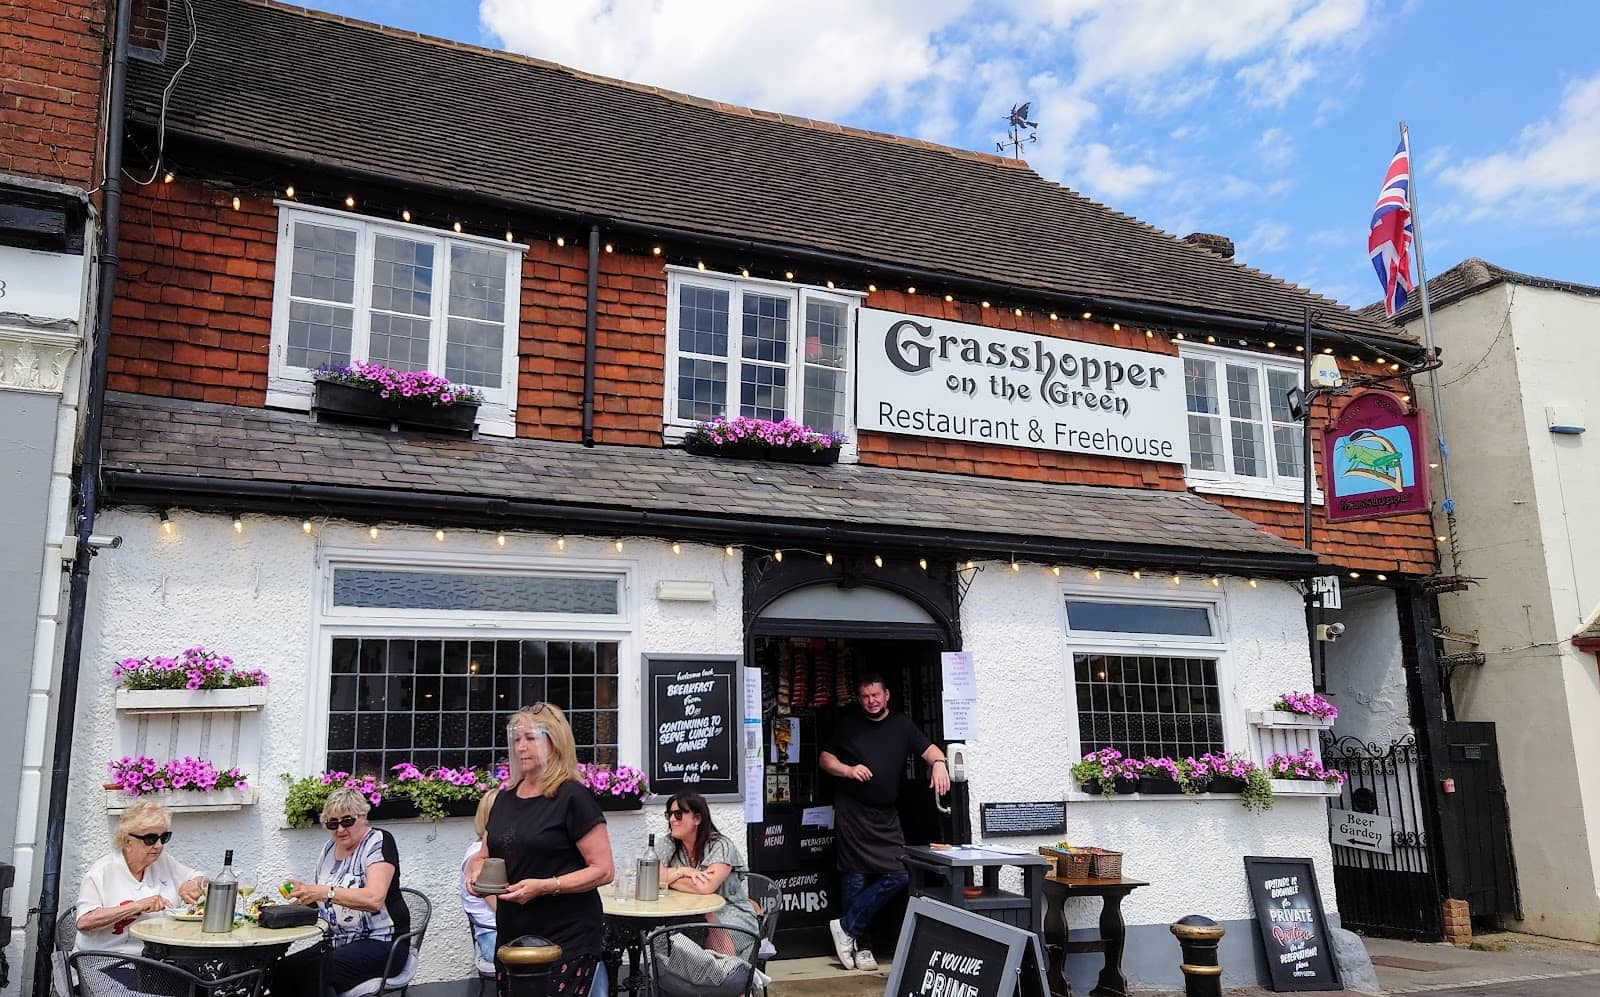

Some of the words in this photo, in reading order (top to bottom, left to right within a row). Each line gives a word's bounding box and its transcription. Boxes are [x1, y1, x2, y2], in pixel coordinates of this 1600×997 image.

[884, 319, 1166, 407] Grasshopper
[946, 374, 976, 398] on
[989, 375, 1031, 401] the
[1047, 381, 1129, 416] Green
[879, 401, 1019, 441] Restaurant
[1027, 419, 1045, 444] &
[1055, 423, 1172, 458] Freehouse
[667, 680, 715, 696] BREAKFAST
[659, 717, 709, 734] CONTINUING
[711, 715, 721, 726] TO
[659, 730, 686, 745] SERVE
[689, 726, 715, 740] LUNCH
[676, 738, 708, 754] DINNER
[765, 824, 783, 835] MAIN
[1346, 813, 1375, 828] Beer
[764, 835, 785, 847] MENU
[1340, 823, 1382, 848] Garden
[788, 873, 818, 888] SEATING
[1270, 908, 1313, 922] PRIVATE
[1272, 922, 1315, 946] Parties
[929, 950, 941, 966] IF
[941, 952, 961, 970] YOU
[959, 955, 983, 975] LIKE
